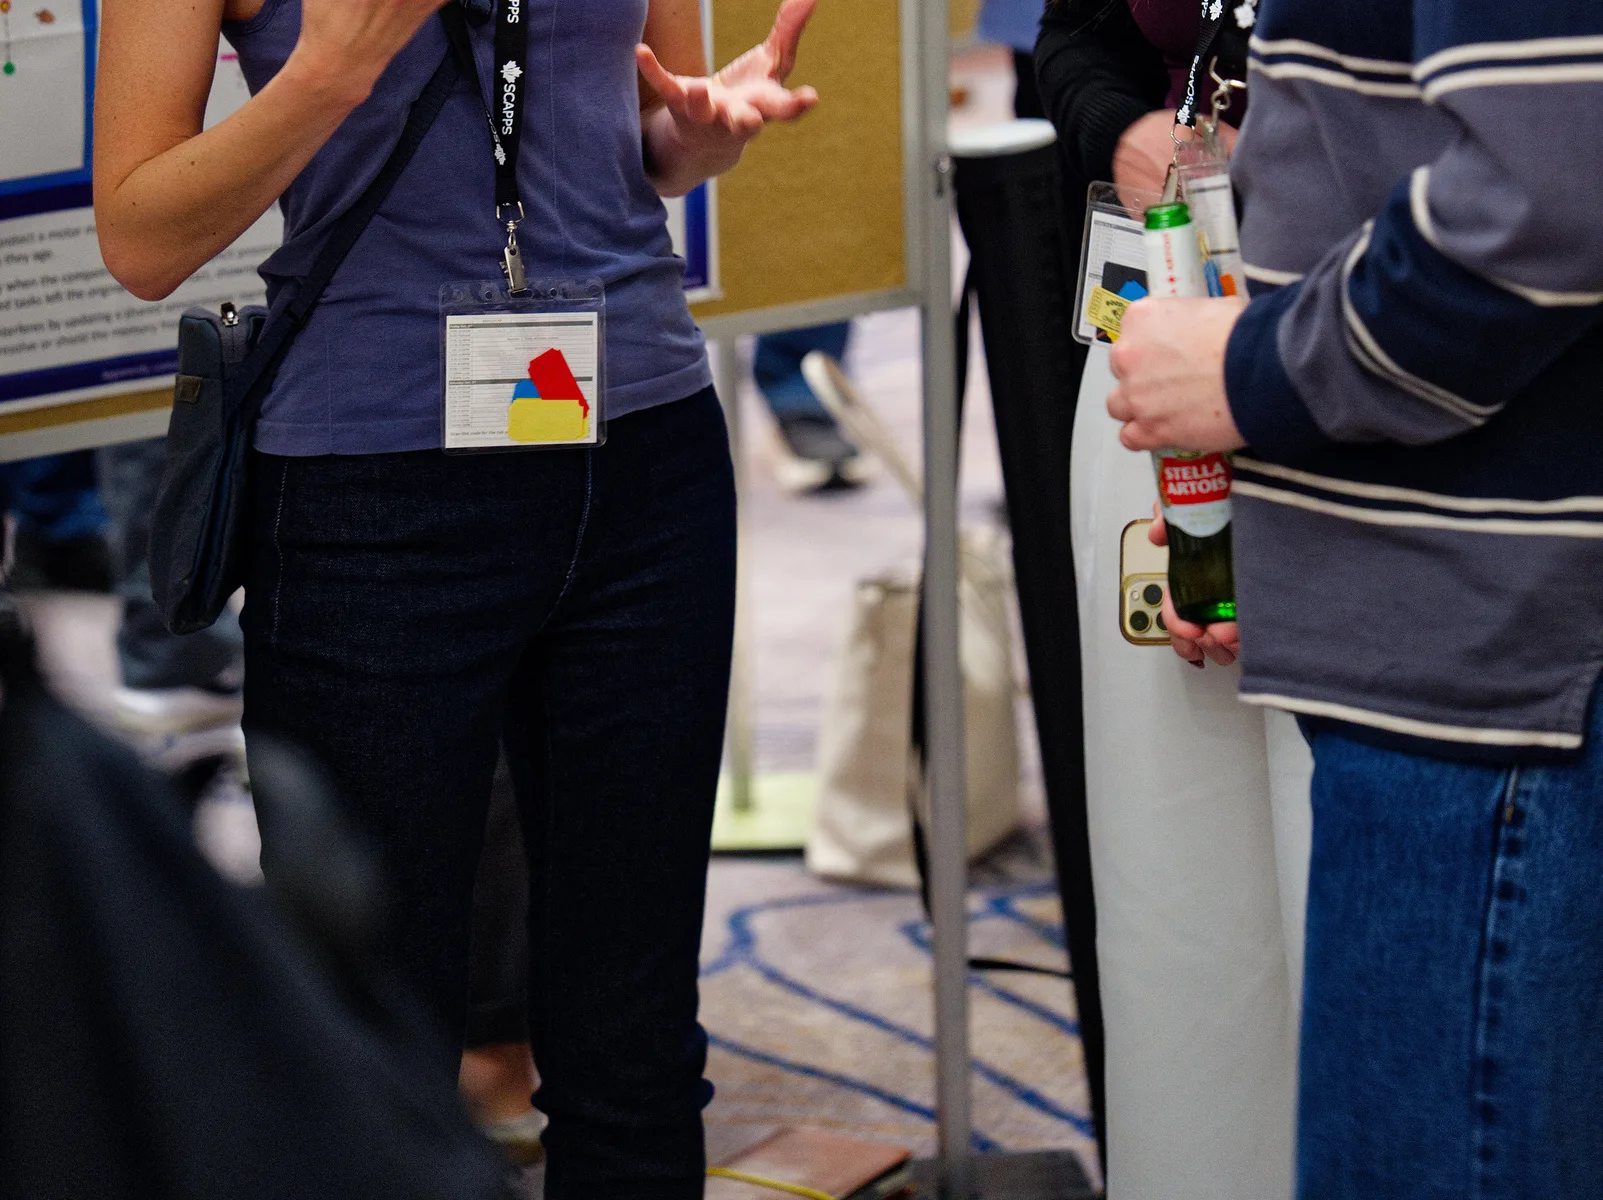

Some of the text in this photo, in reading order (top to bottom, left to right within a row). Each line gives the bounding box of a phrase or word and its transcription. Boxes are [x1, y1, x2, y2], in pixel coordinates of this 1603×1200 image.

[1185, 55, 1200, 106] SCAPPS
[502, 83, 516, 135] SCAPPS
[1164, 461, 1225, 481] STELLA
[1166, 476, 1229, 496] ARTOIS
